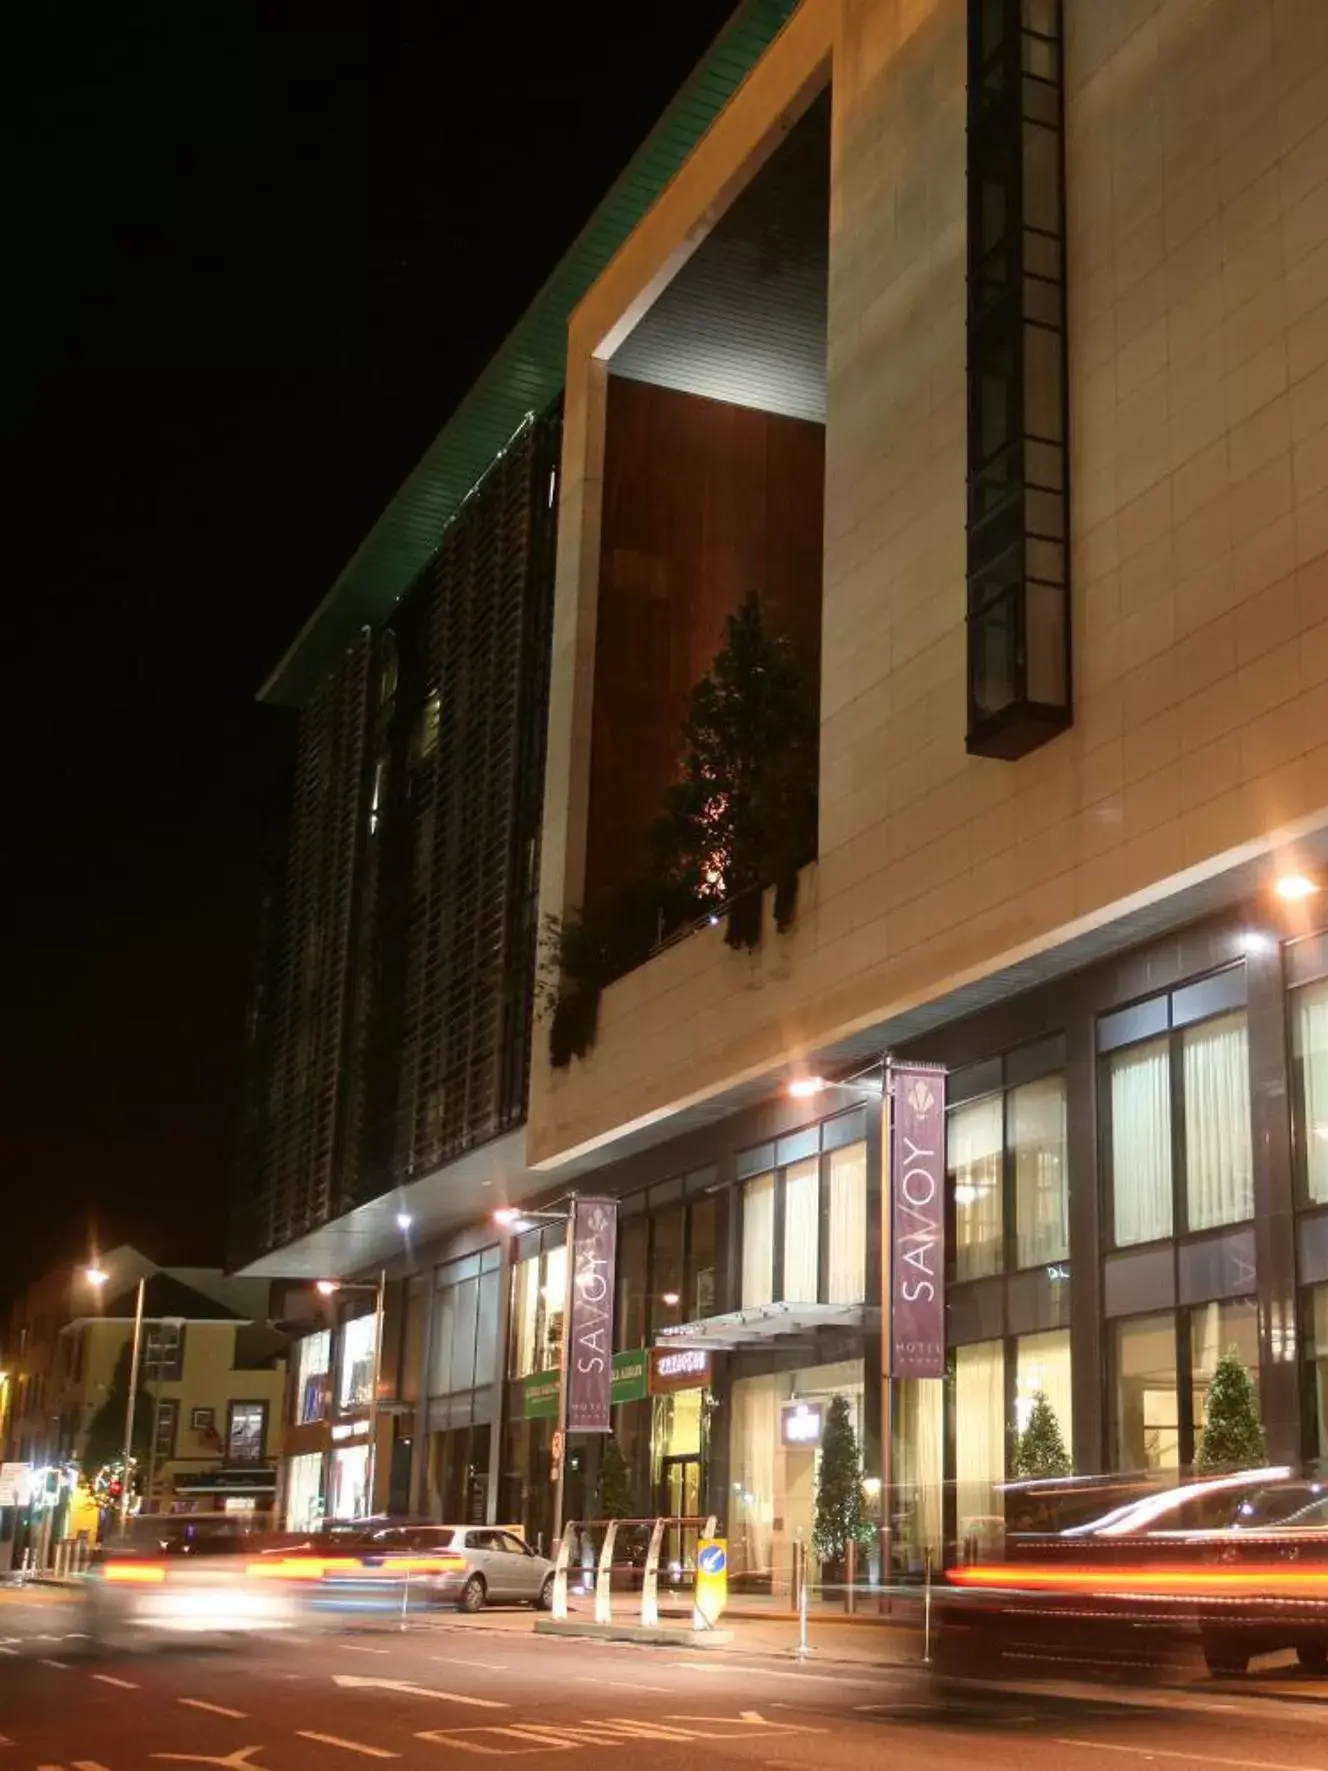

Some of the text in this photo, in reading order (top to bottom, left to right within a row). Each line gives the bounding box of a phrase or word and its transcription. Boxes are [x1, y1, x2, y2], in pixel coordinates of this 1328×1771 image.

[902, 1137, 936, 1303] SAVOY
[577, 1251, 608, 1375] SAVOY
[895, 1341, 940, 1354] HOTEL
[413, 1710, 829, 1755] ONLY
